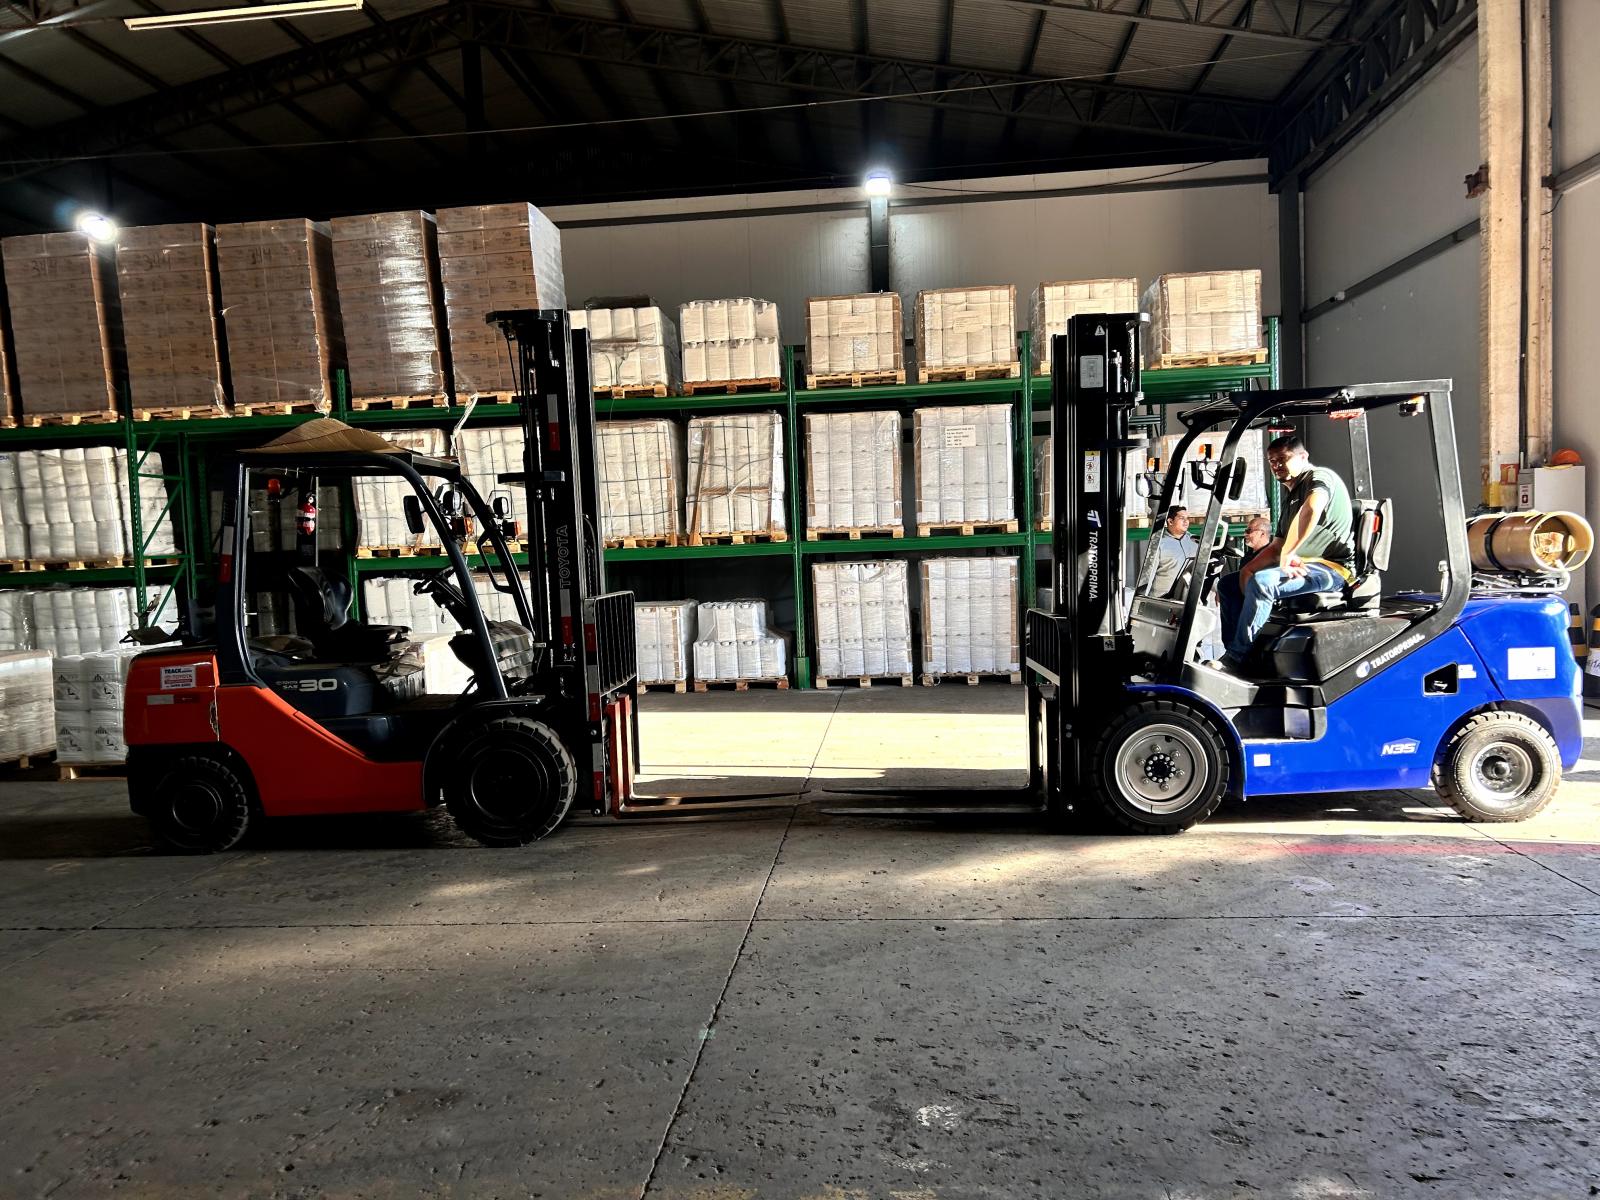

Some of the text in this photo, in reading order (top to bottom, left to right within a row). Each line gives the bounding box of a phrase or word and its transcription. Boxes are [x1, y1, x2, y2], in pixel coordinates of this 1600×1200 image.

[556, 524, 571, 589] TOYOTA
[1088, 530, 1099, 600] TRATORPRIMA
[1370, 633, 1424, 669] TRATORPRIMA
[299, 678, 338, 692] 30
